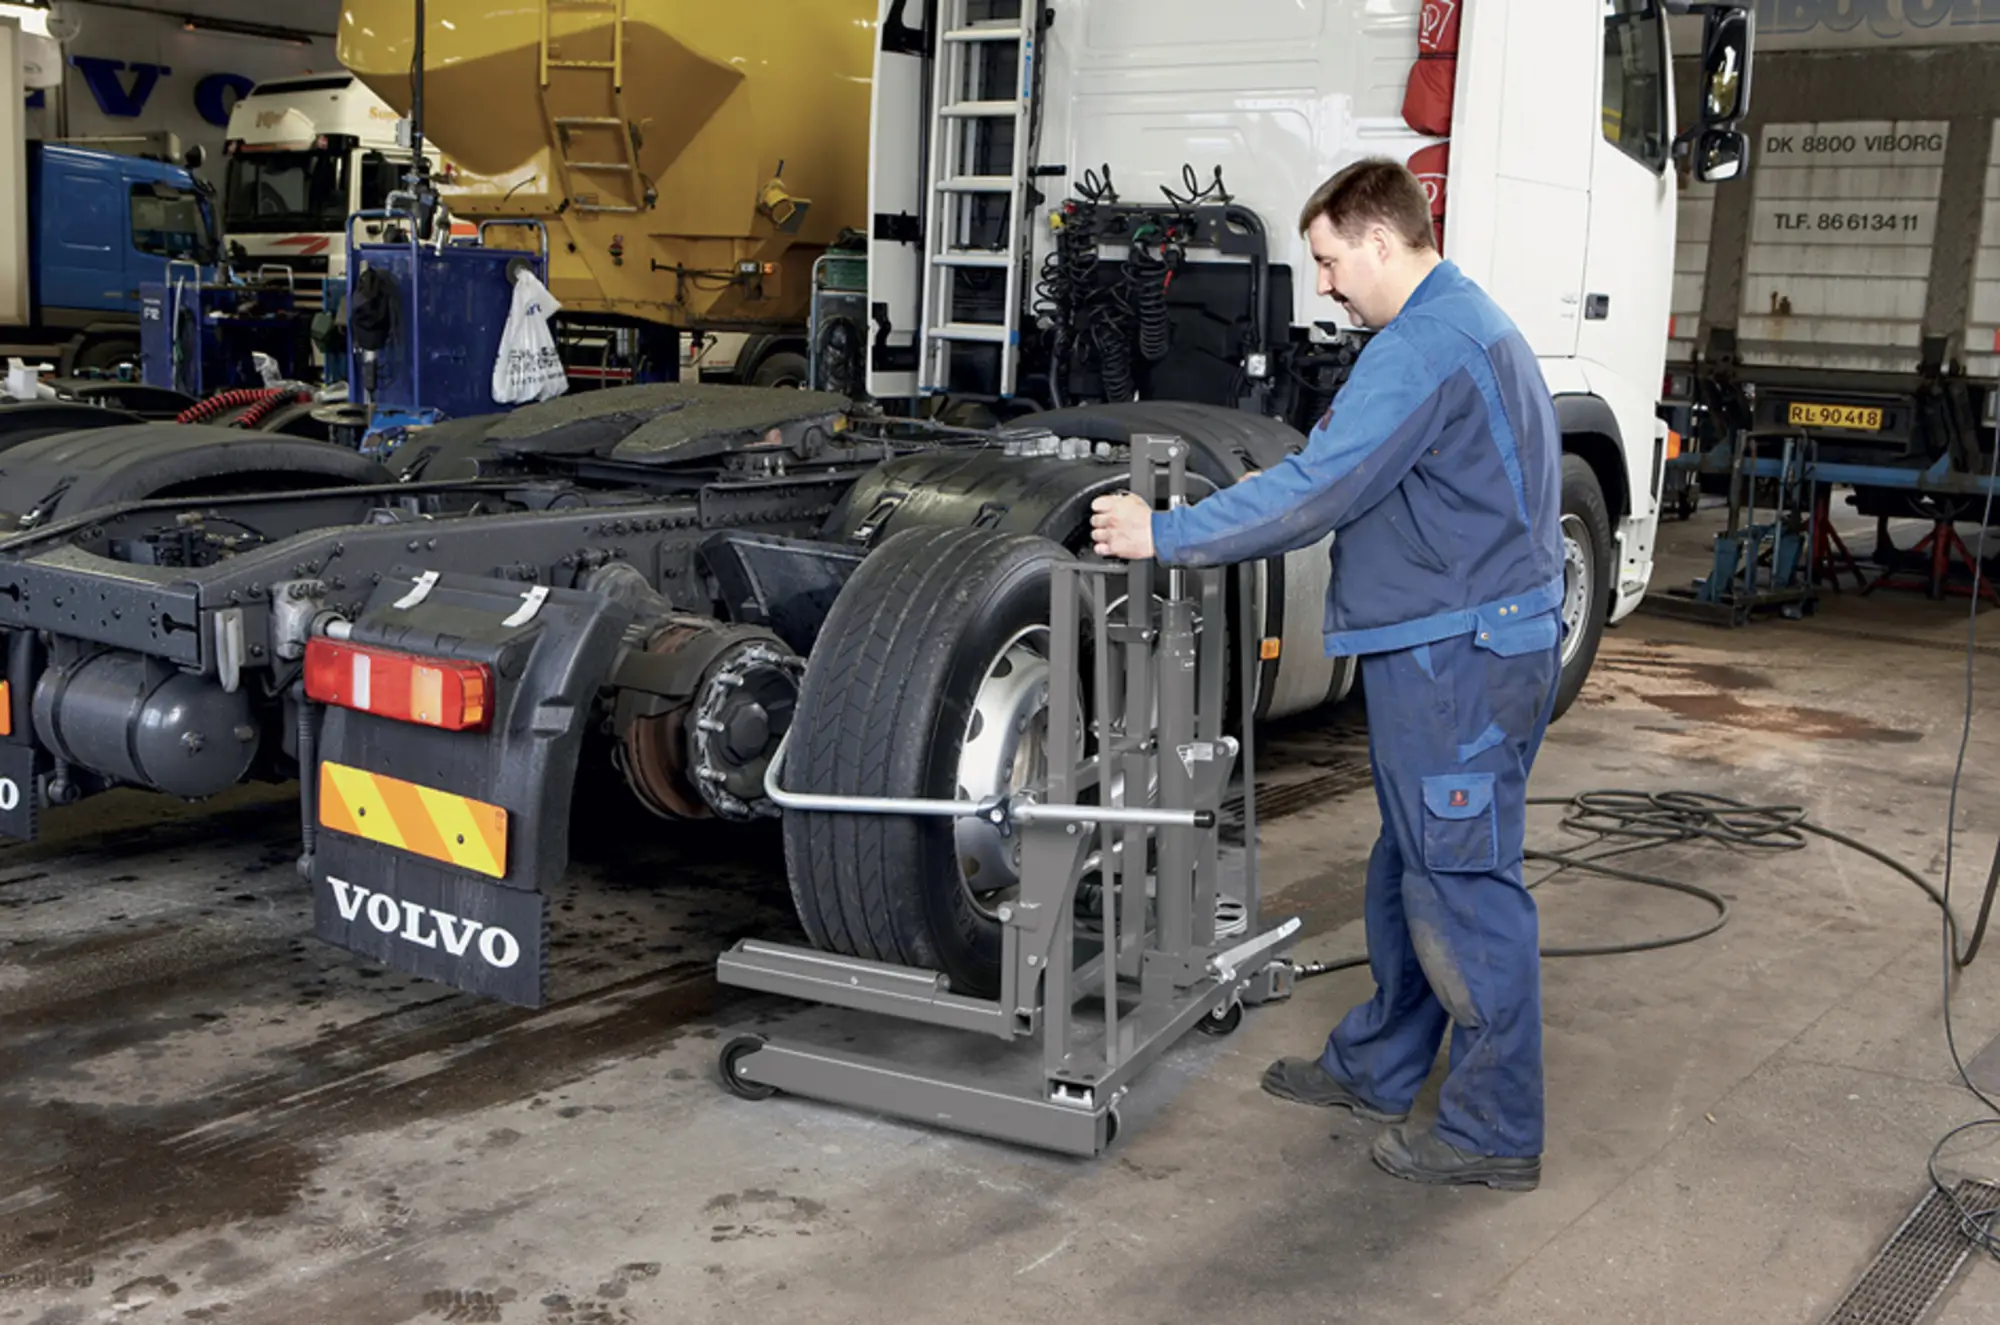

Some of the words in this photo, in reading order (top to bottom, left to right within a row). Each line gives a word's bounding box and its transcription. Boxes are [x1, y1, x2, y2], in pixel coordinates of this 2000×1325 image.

[1766, 136, 1794, 153] DK
[1802, 135, 1856, 153] 8800
[1864, 134, 1943, 152] VIBORG
[1773, 213, 1811, 230] TLF.
[326, 875, 520, 969] VOLVO
